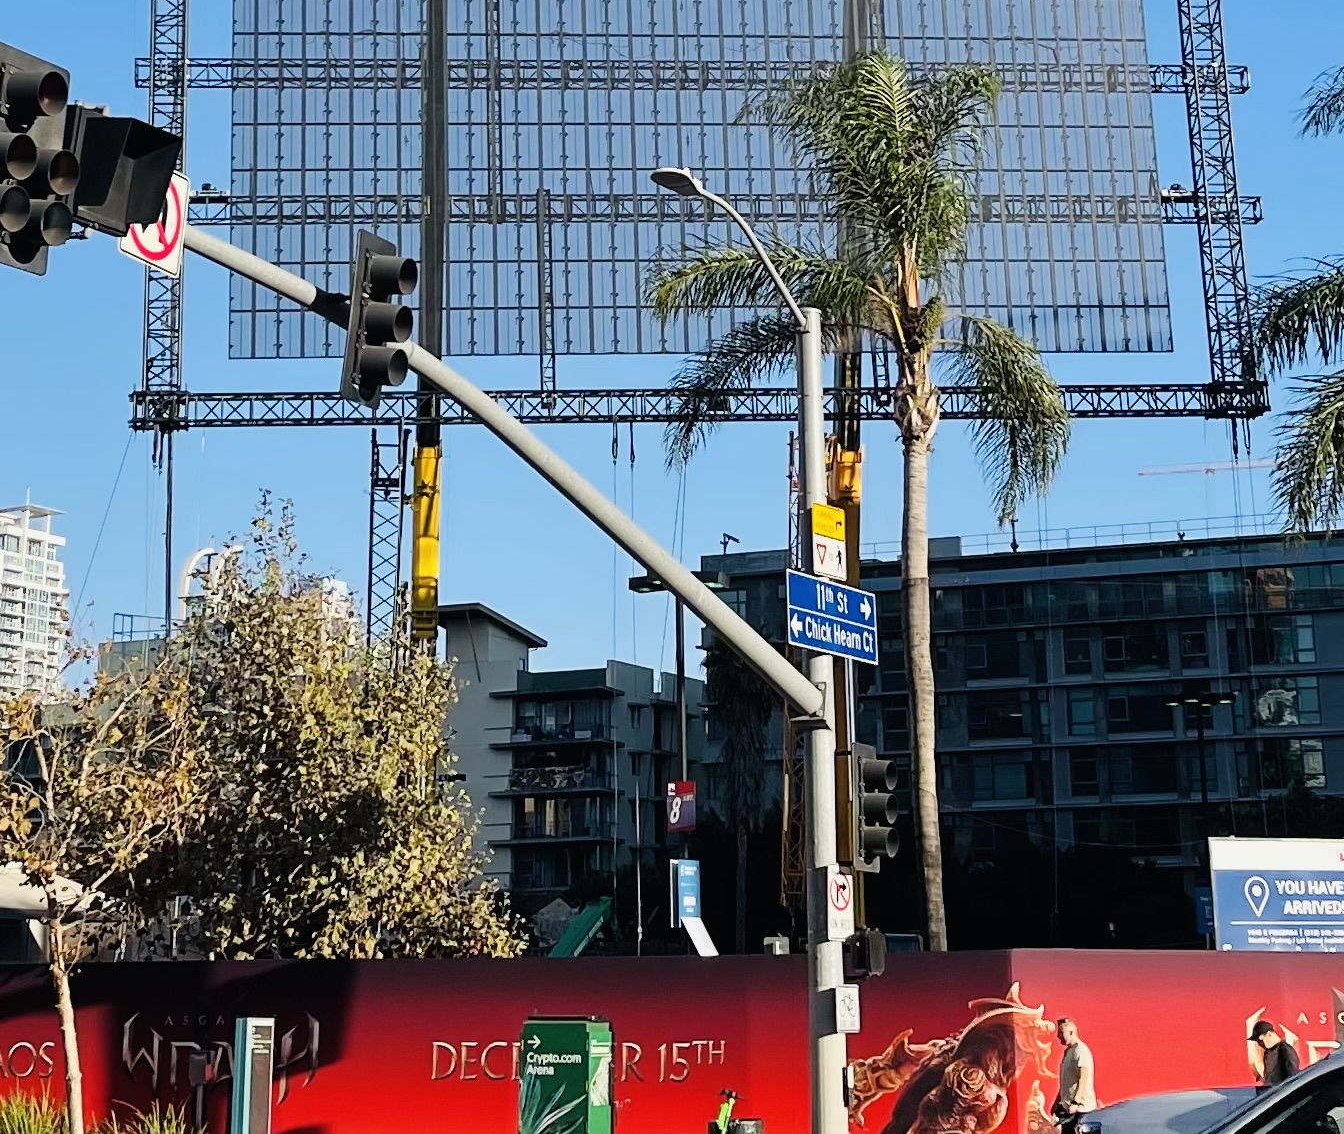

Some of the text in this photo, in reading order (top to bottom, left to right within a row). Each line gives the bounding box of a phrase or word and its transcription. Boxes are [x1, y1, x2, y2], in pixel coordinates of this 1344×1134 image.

[816, 582, 849, 615] 11th St
[805, 616, 874, 654] Chick Hearn Ct
[670, 796, 682, 825] 8
[1275, 880, 1306, 896] YOU
[526, 1052, 582, 1066] Crypto.com
[526, 1064, 555, 1076] Arena
